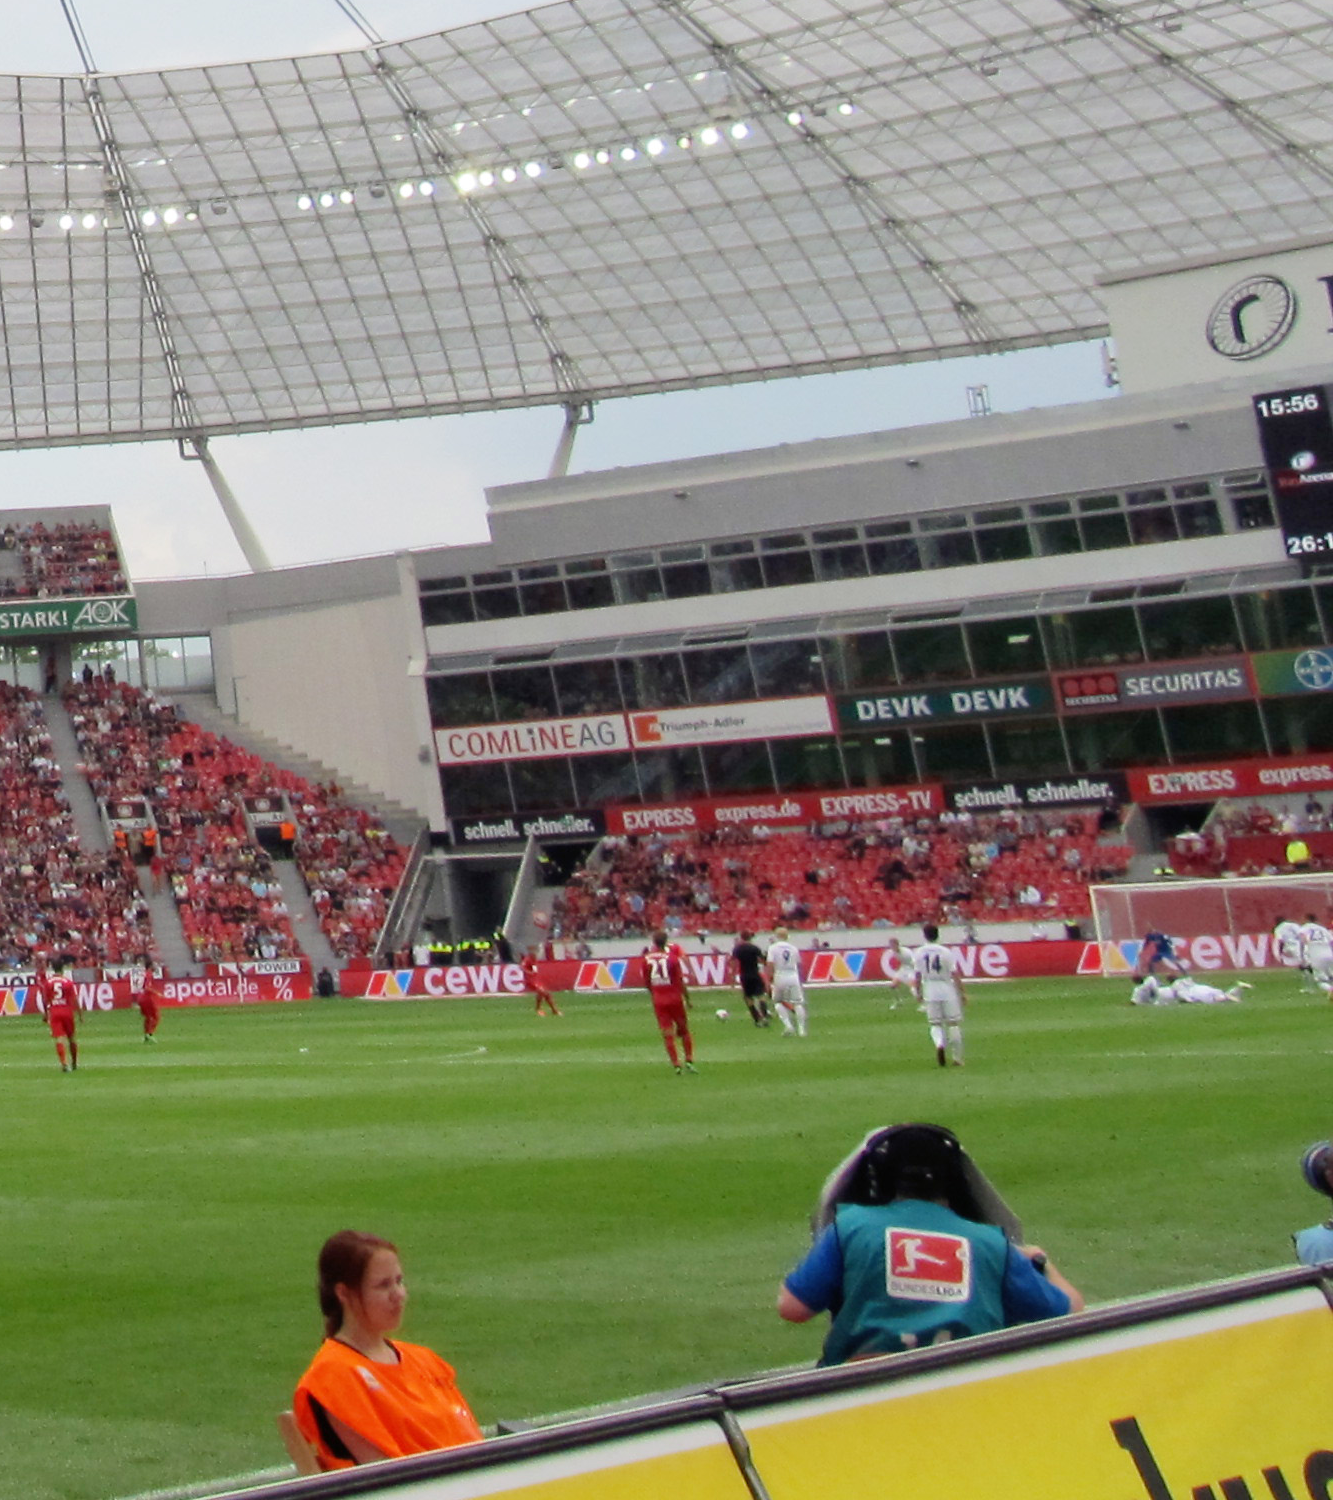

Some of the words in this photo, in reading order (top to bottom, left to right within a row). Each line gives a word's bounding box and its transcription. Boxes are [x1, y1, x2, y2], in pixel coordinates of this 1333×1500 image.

[1257, 394, 1318, 417] 15:56
[74, 600, 129, 623] AOK
[1125, 668, 1243, 696] SECURITAS
[856, 695, 932, 721] DEVK
[950, 686, 1030, 713] DEVK
[660, 716, 746, 732] Triumph-Adler
[1147, 768, 1236, 794] EXPRESS
[954, 784, 1023, 808] schnell.
[1027, 779, 1114, 803] schneller.
[622, 807, 696, 830] EXPRESS
[715, 799, 801, 823] express.de
[820, 790, 931, 817] EXPRESS-TV
[464, 819, 520, 840] schnell.
[523, 815, 595, 836] schneller.
[256, 961, 300, 973] POWER
[647, 959, 669, 980] 21
[925, 952, 941, 973] 14
[53, 982, 63, 999] 5
[163, 978, 259, 1002] apotal.de
[423, 964, 525, 996] cewe
